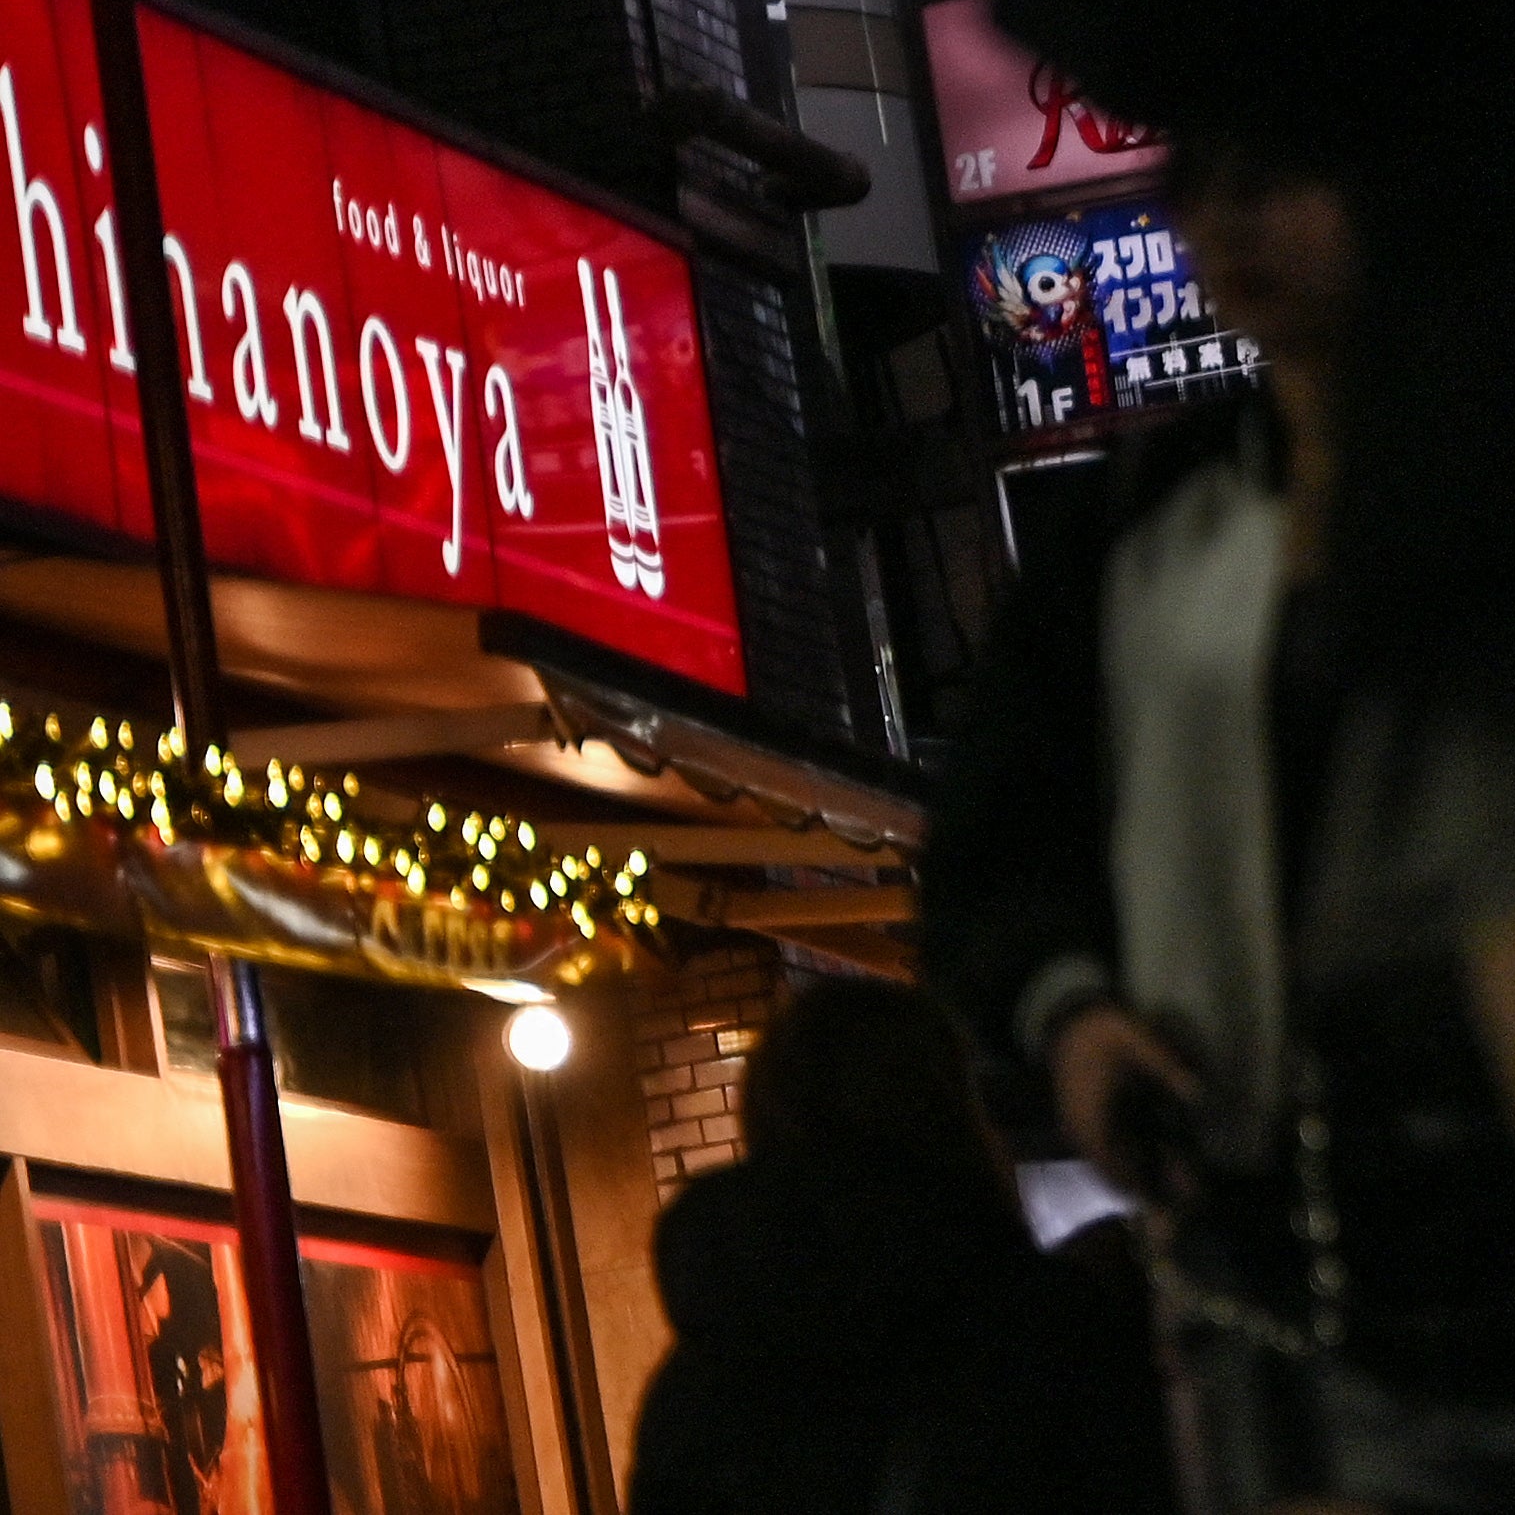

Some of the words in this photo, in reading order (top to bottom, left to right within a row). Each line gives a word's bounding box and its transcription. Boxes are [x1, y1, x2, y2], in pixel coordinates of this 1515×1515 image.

[955, 150, 997, 190] 2F
[333, 176, 400, 257] food
[413, 214, 431, 268] &
[441, 223, 525, 309] liquor
[1103, 281, 1202, 333] インフォ
[1016, 379, 1073, 427] 1F
